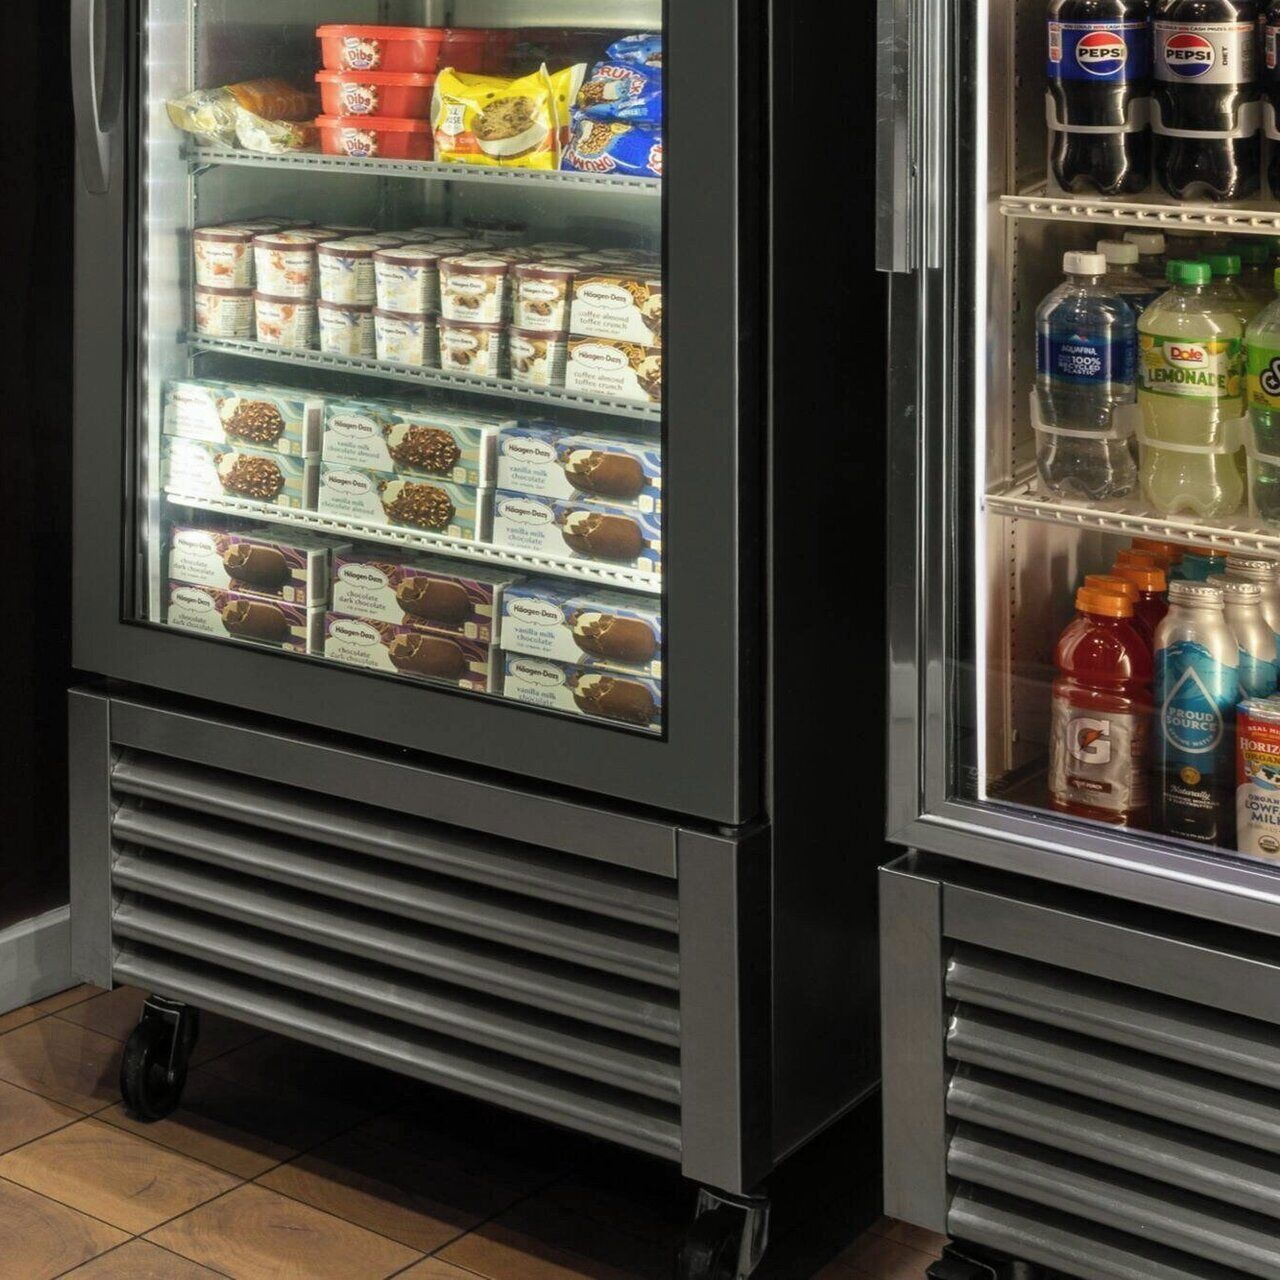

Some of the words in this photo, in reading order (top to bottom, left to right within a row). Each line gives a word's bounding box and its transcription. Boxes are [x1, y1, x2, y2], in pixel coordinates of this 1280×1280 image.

[348, 47, 373, 63] Dibs
[1078, 47, 1125, 59] PEPSI
[1166, 49, 1212, 61] PEPSI
[348, 93, 372, 108] Dibs
[346, 138, 370, 151] Dibs
[1061, 345, 1097, 355] AQUAFINA
[1170, 347, 1202, 361] Dole
[1072, 356, 1101, 366] 100%
[1148, 369, 1226, 389] LEMONADE
[1169, 707, 1214, 722] PROUD
[1166, 717, 1218, 732] SOURCE
[1068, 718, 1111, 764] G
[1171, 786, 1211, 801] Naturally
